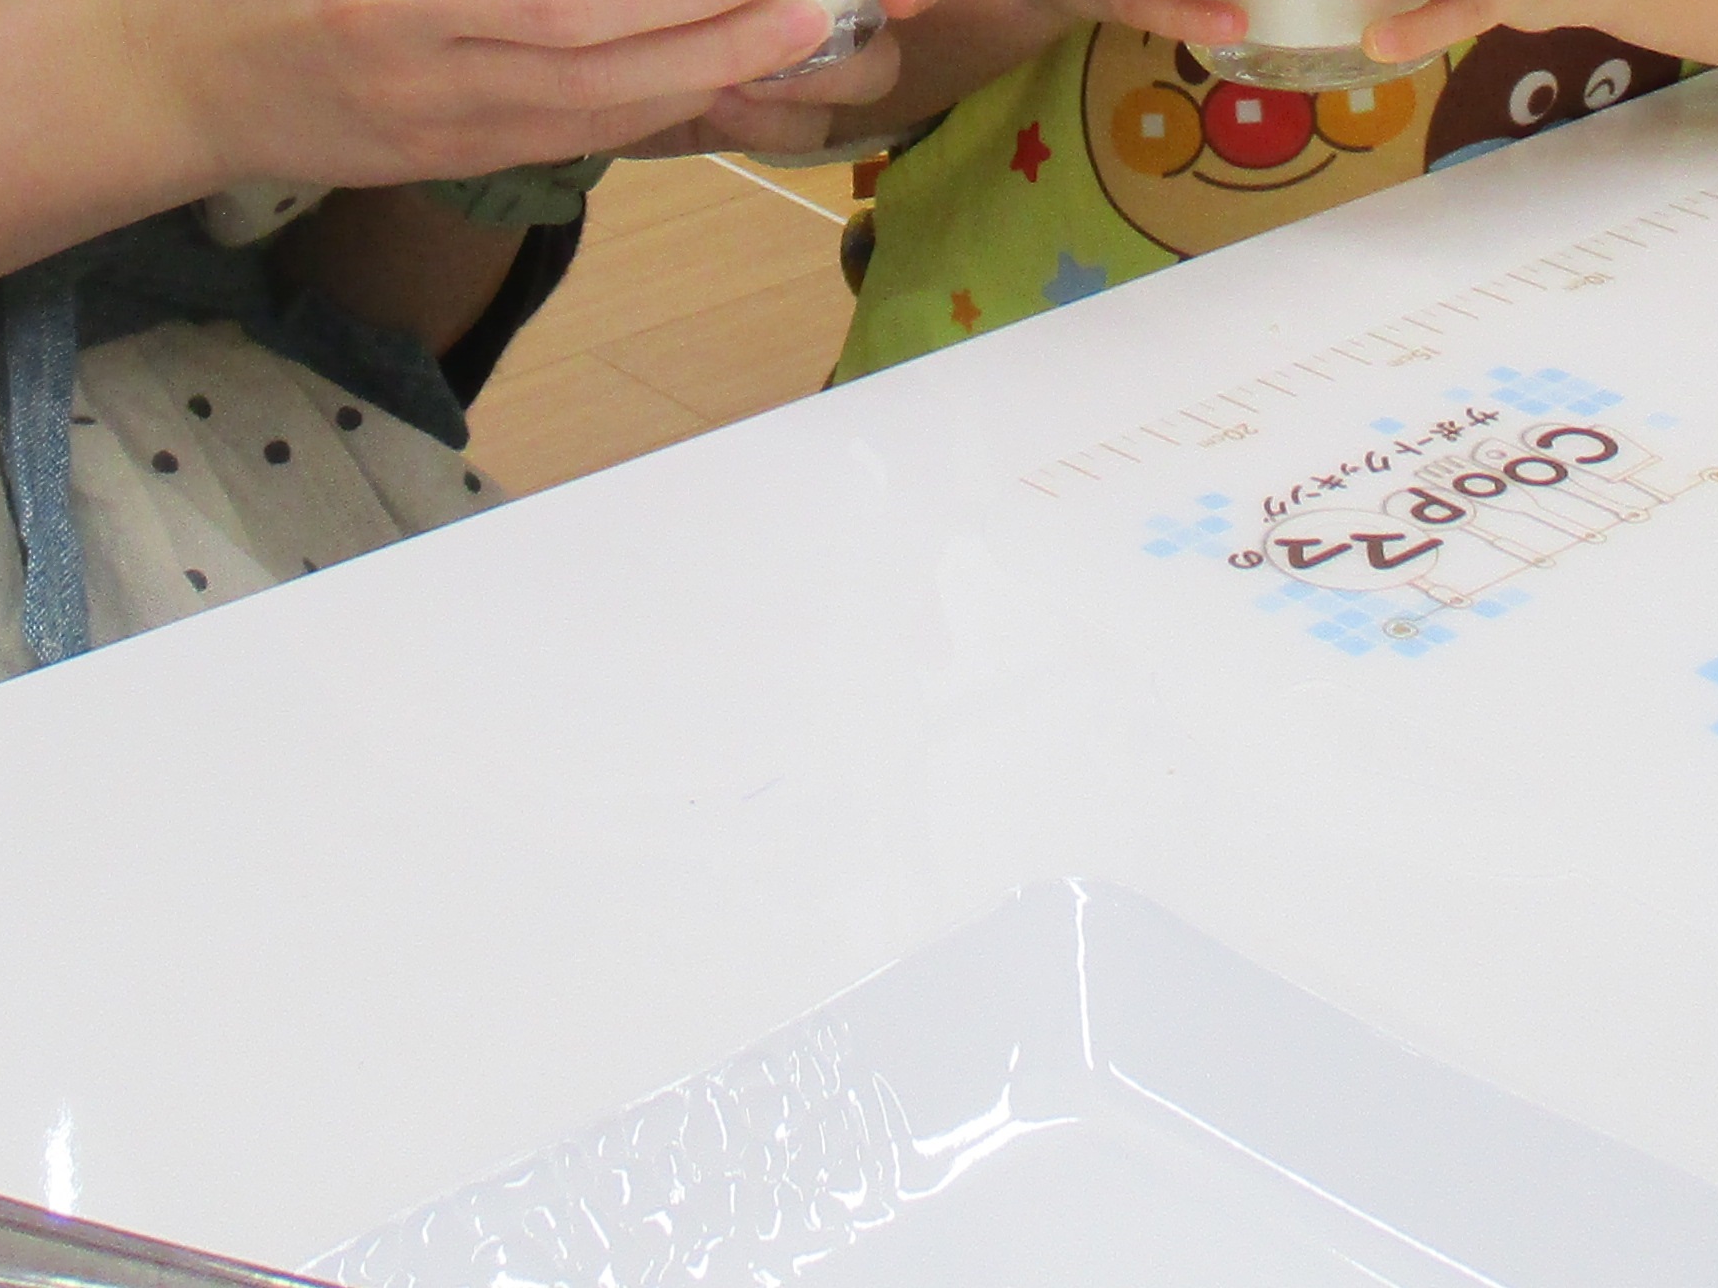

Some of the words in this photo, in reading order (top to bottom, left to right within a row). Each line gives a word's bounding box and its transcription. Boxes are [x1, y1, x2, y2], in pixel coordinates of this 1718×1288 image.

[1262, 407, 1501, 524] サポートクッキング
